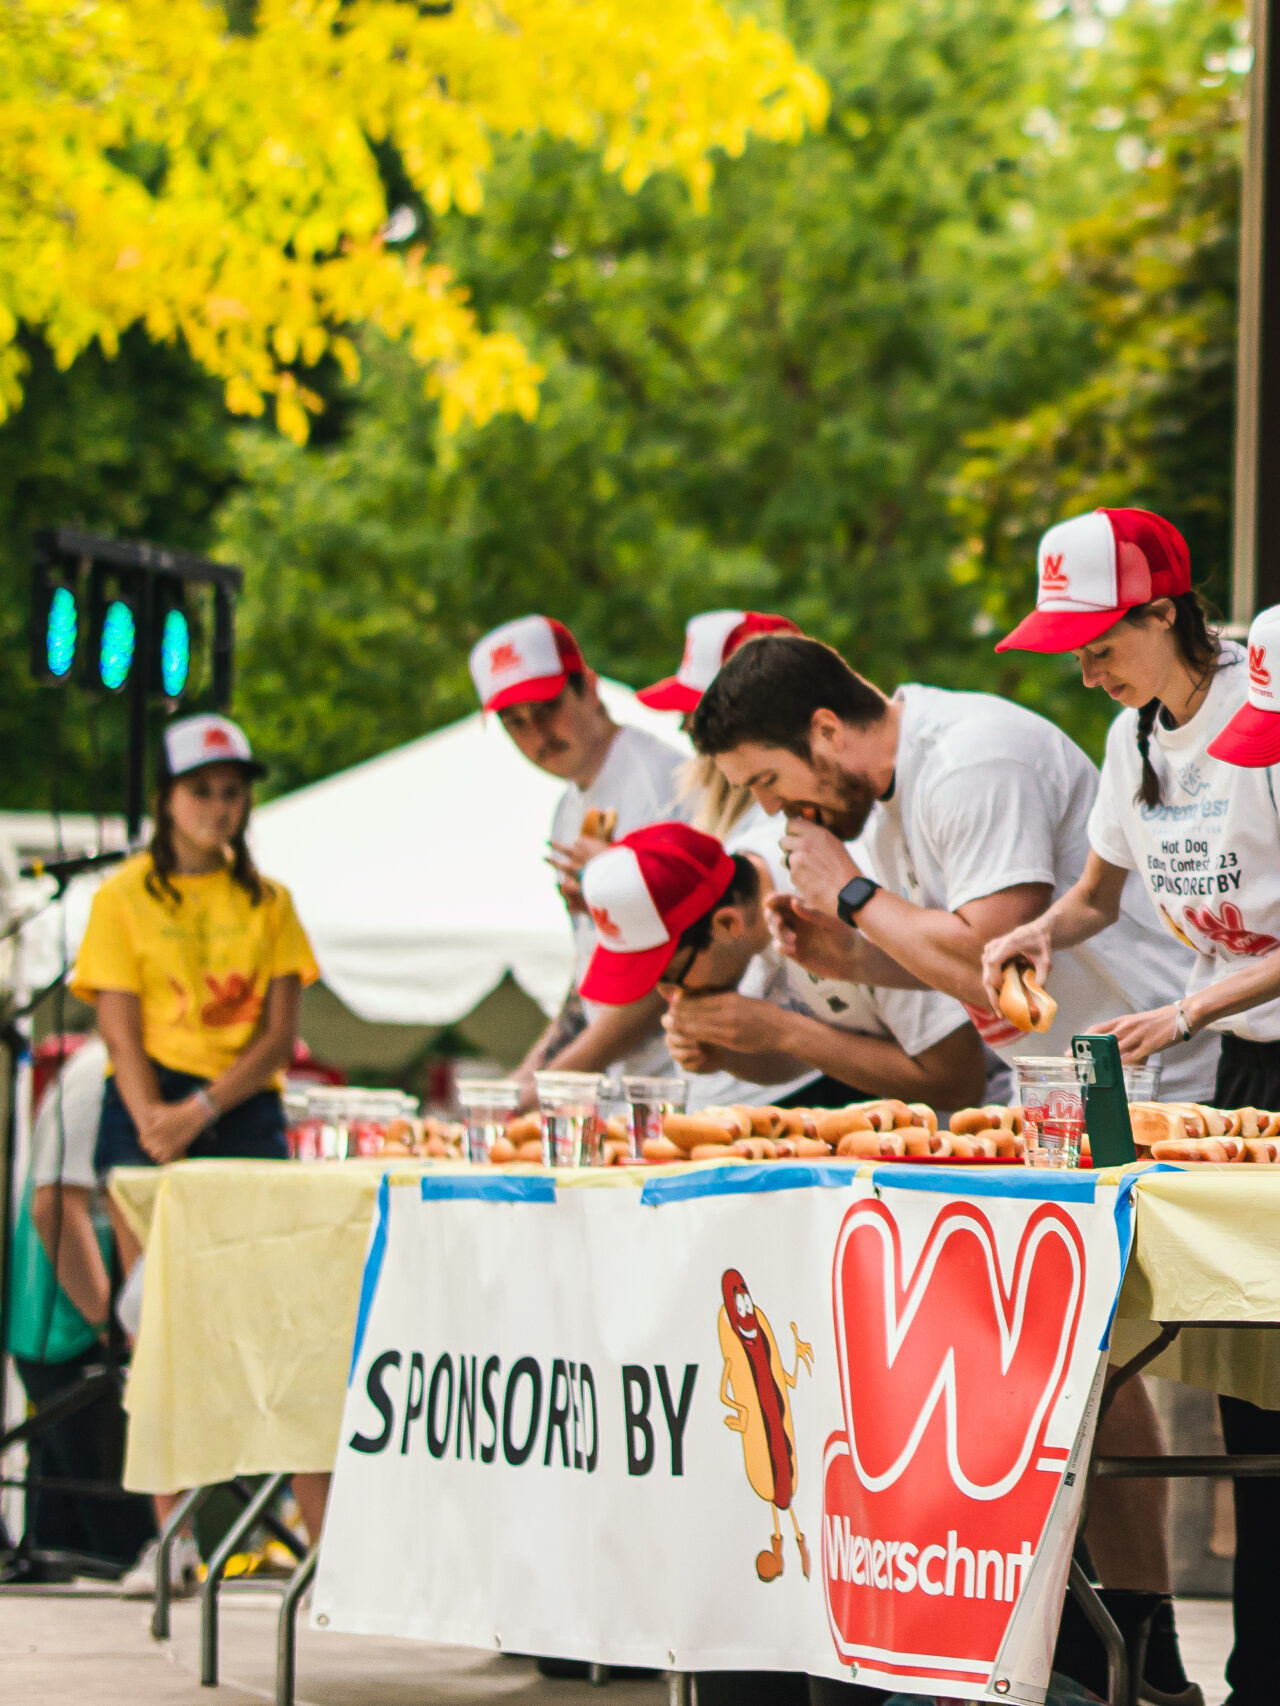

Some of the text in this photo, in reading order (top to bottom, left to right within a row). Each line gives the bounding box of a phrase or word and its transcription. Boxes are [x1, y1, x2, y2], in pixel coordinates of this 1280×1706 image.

[1161, 838, 1209, 858] Hot Dog
[1216, 869, 1242, 894] BY
[348, 1349, 701, 1478] SPONSORED BY
[823, 1513, 1036, 1603] Wienerschnit
